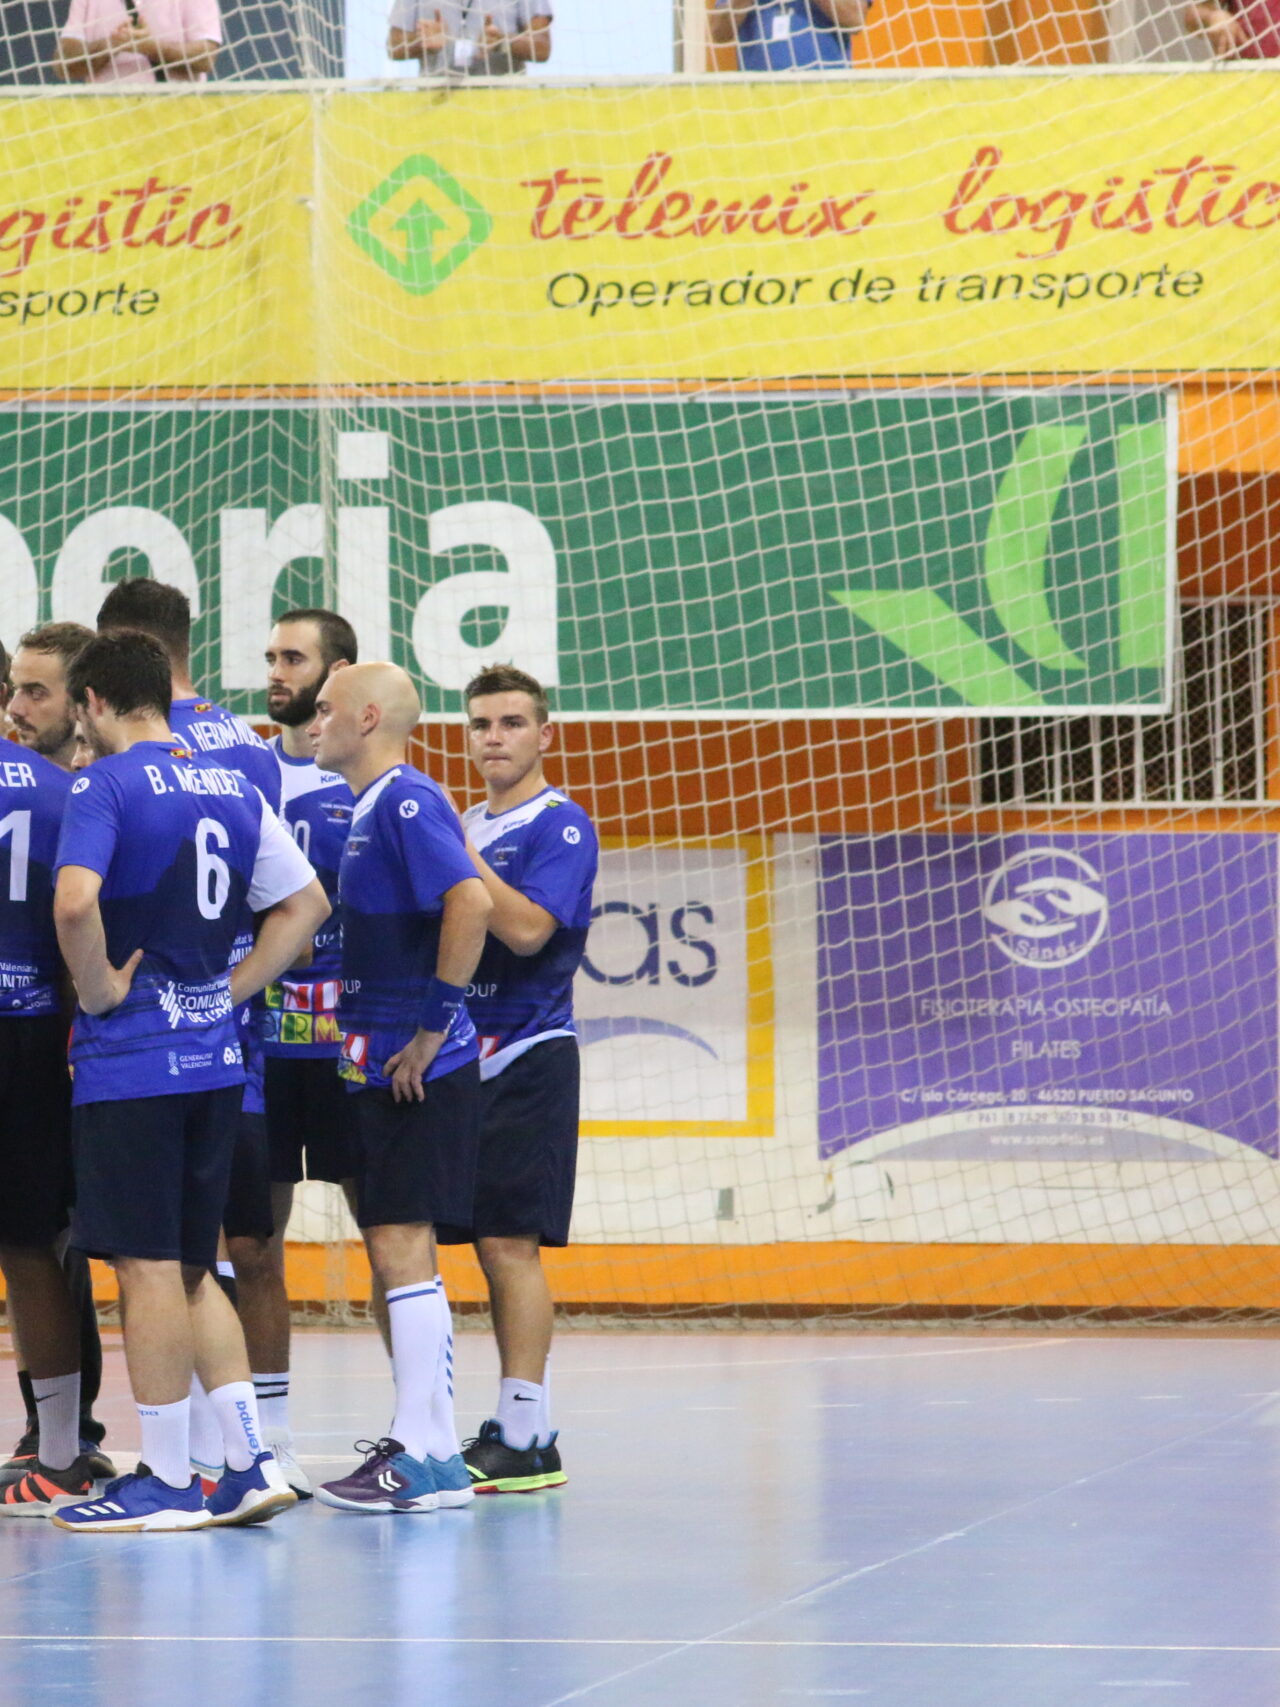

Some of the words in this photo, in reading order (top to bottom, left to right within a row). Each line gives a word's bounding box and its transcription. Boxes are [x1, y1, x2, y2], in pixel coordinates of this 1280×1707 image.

[520, 152, 877, 242] telemix
[942, 146, 1280, 261] logistic
[547, 272, 813, 317] Operador
[828, 269, 895, 304] de
[918, 264, 1205, 310] transporte
[144, 765, 175, 795] B.
[171, 764, 244, 798] MÉNDEZ
[194, 817, 230, 920] 6
[1011, 1040, 1082, 1060] PILATES
